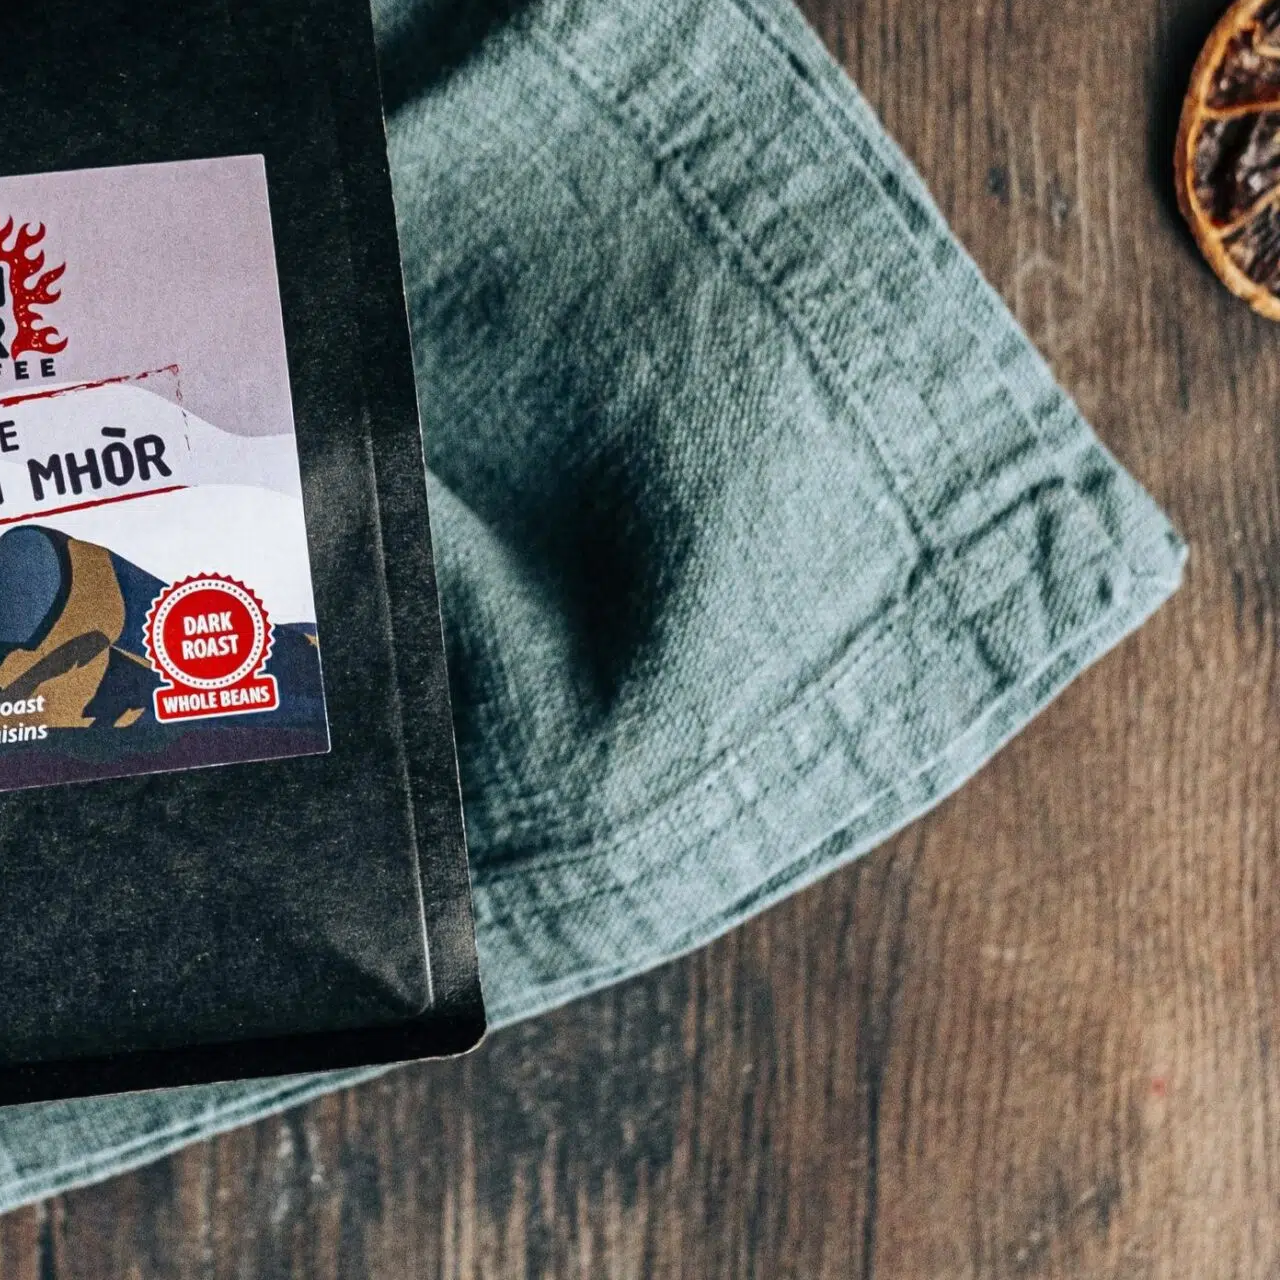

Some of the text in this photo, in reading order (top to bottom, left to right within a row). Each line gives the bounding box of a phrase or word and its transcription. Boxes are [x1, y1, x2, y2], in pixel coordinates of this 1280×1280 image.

[183, 611, 233, 636] DARK
[181, 635, 239, 660] ROAST
[163, 686, 270, 714] WHOLE BEANS
